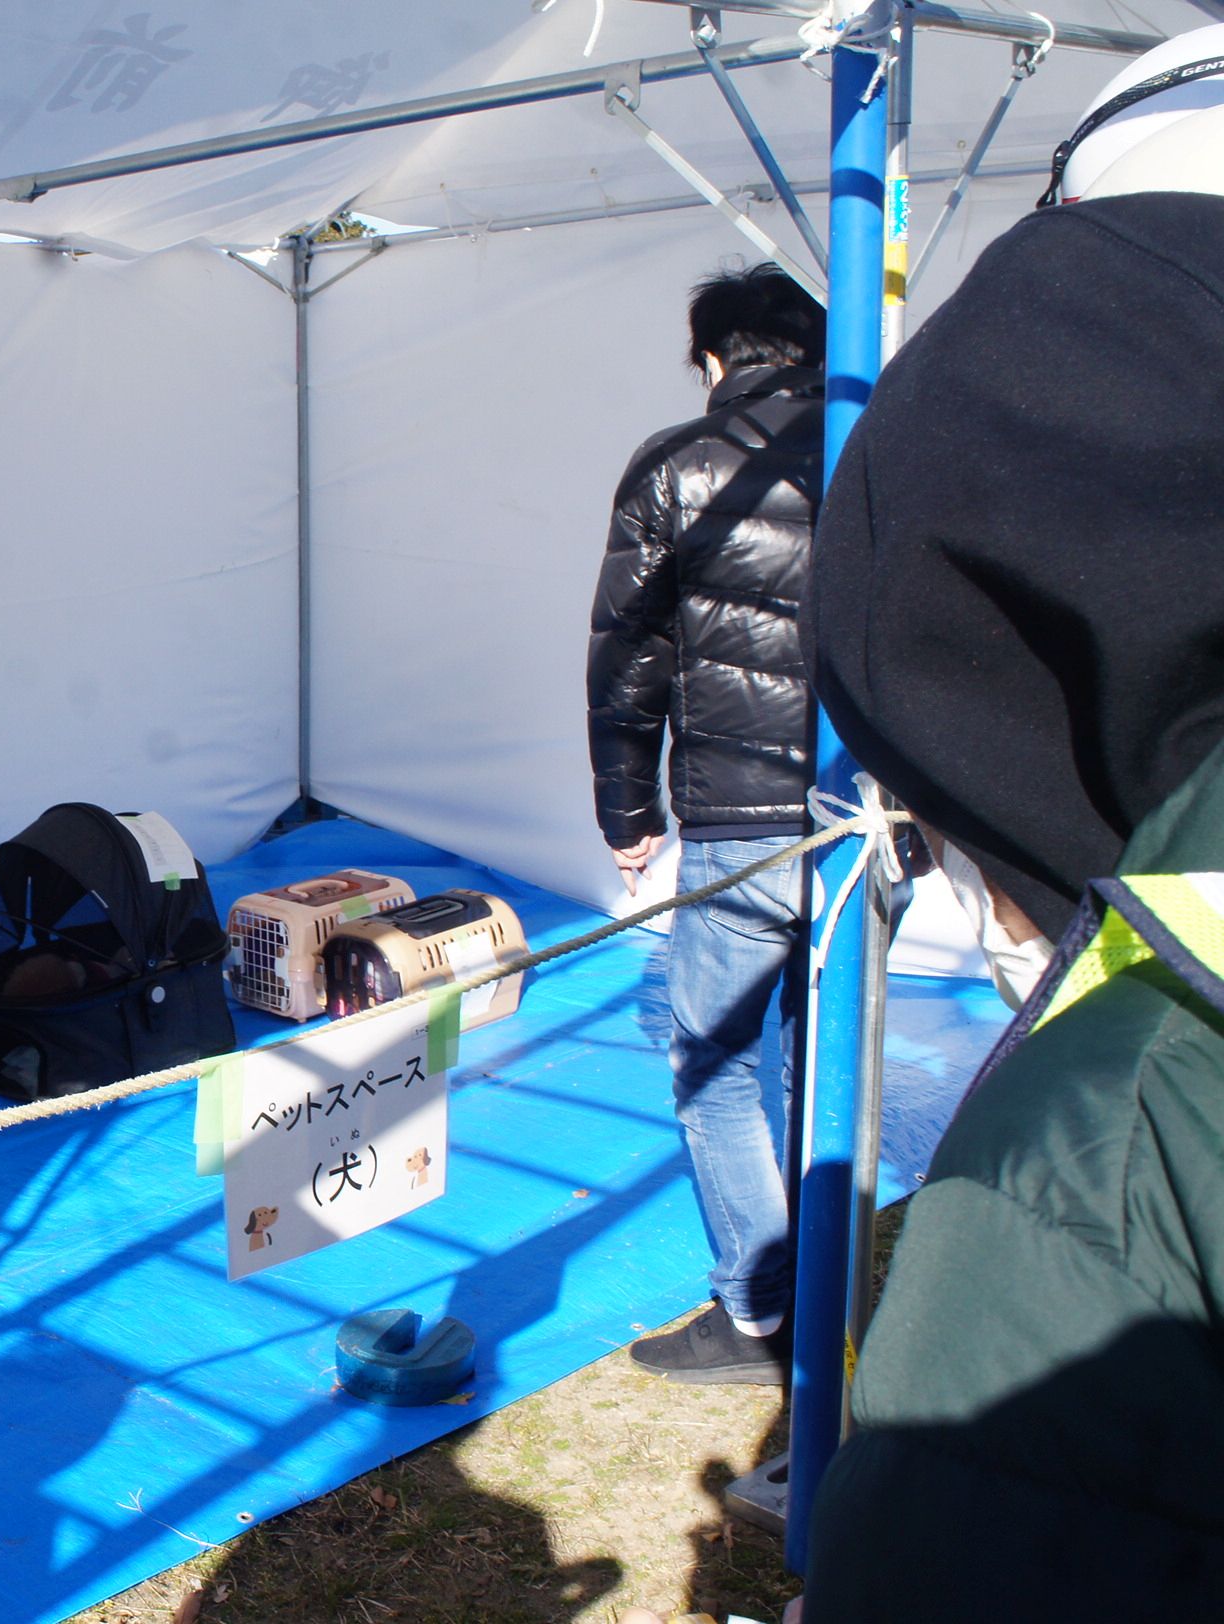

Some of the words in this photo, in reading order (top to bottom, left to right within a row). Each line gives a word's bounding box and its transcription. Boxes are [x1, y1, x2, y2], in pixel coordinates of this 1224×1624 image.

[251, 1056, 426, 1131] ペットスペース
[329, 1128, 361, 1147] いぬ
